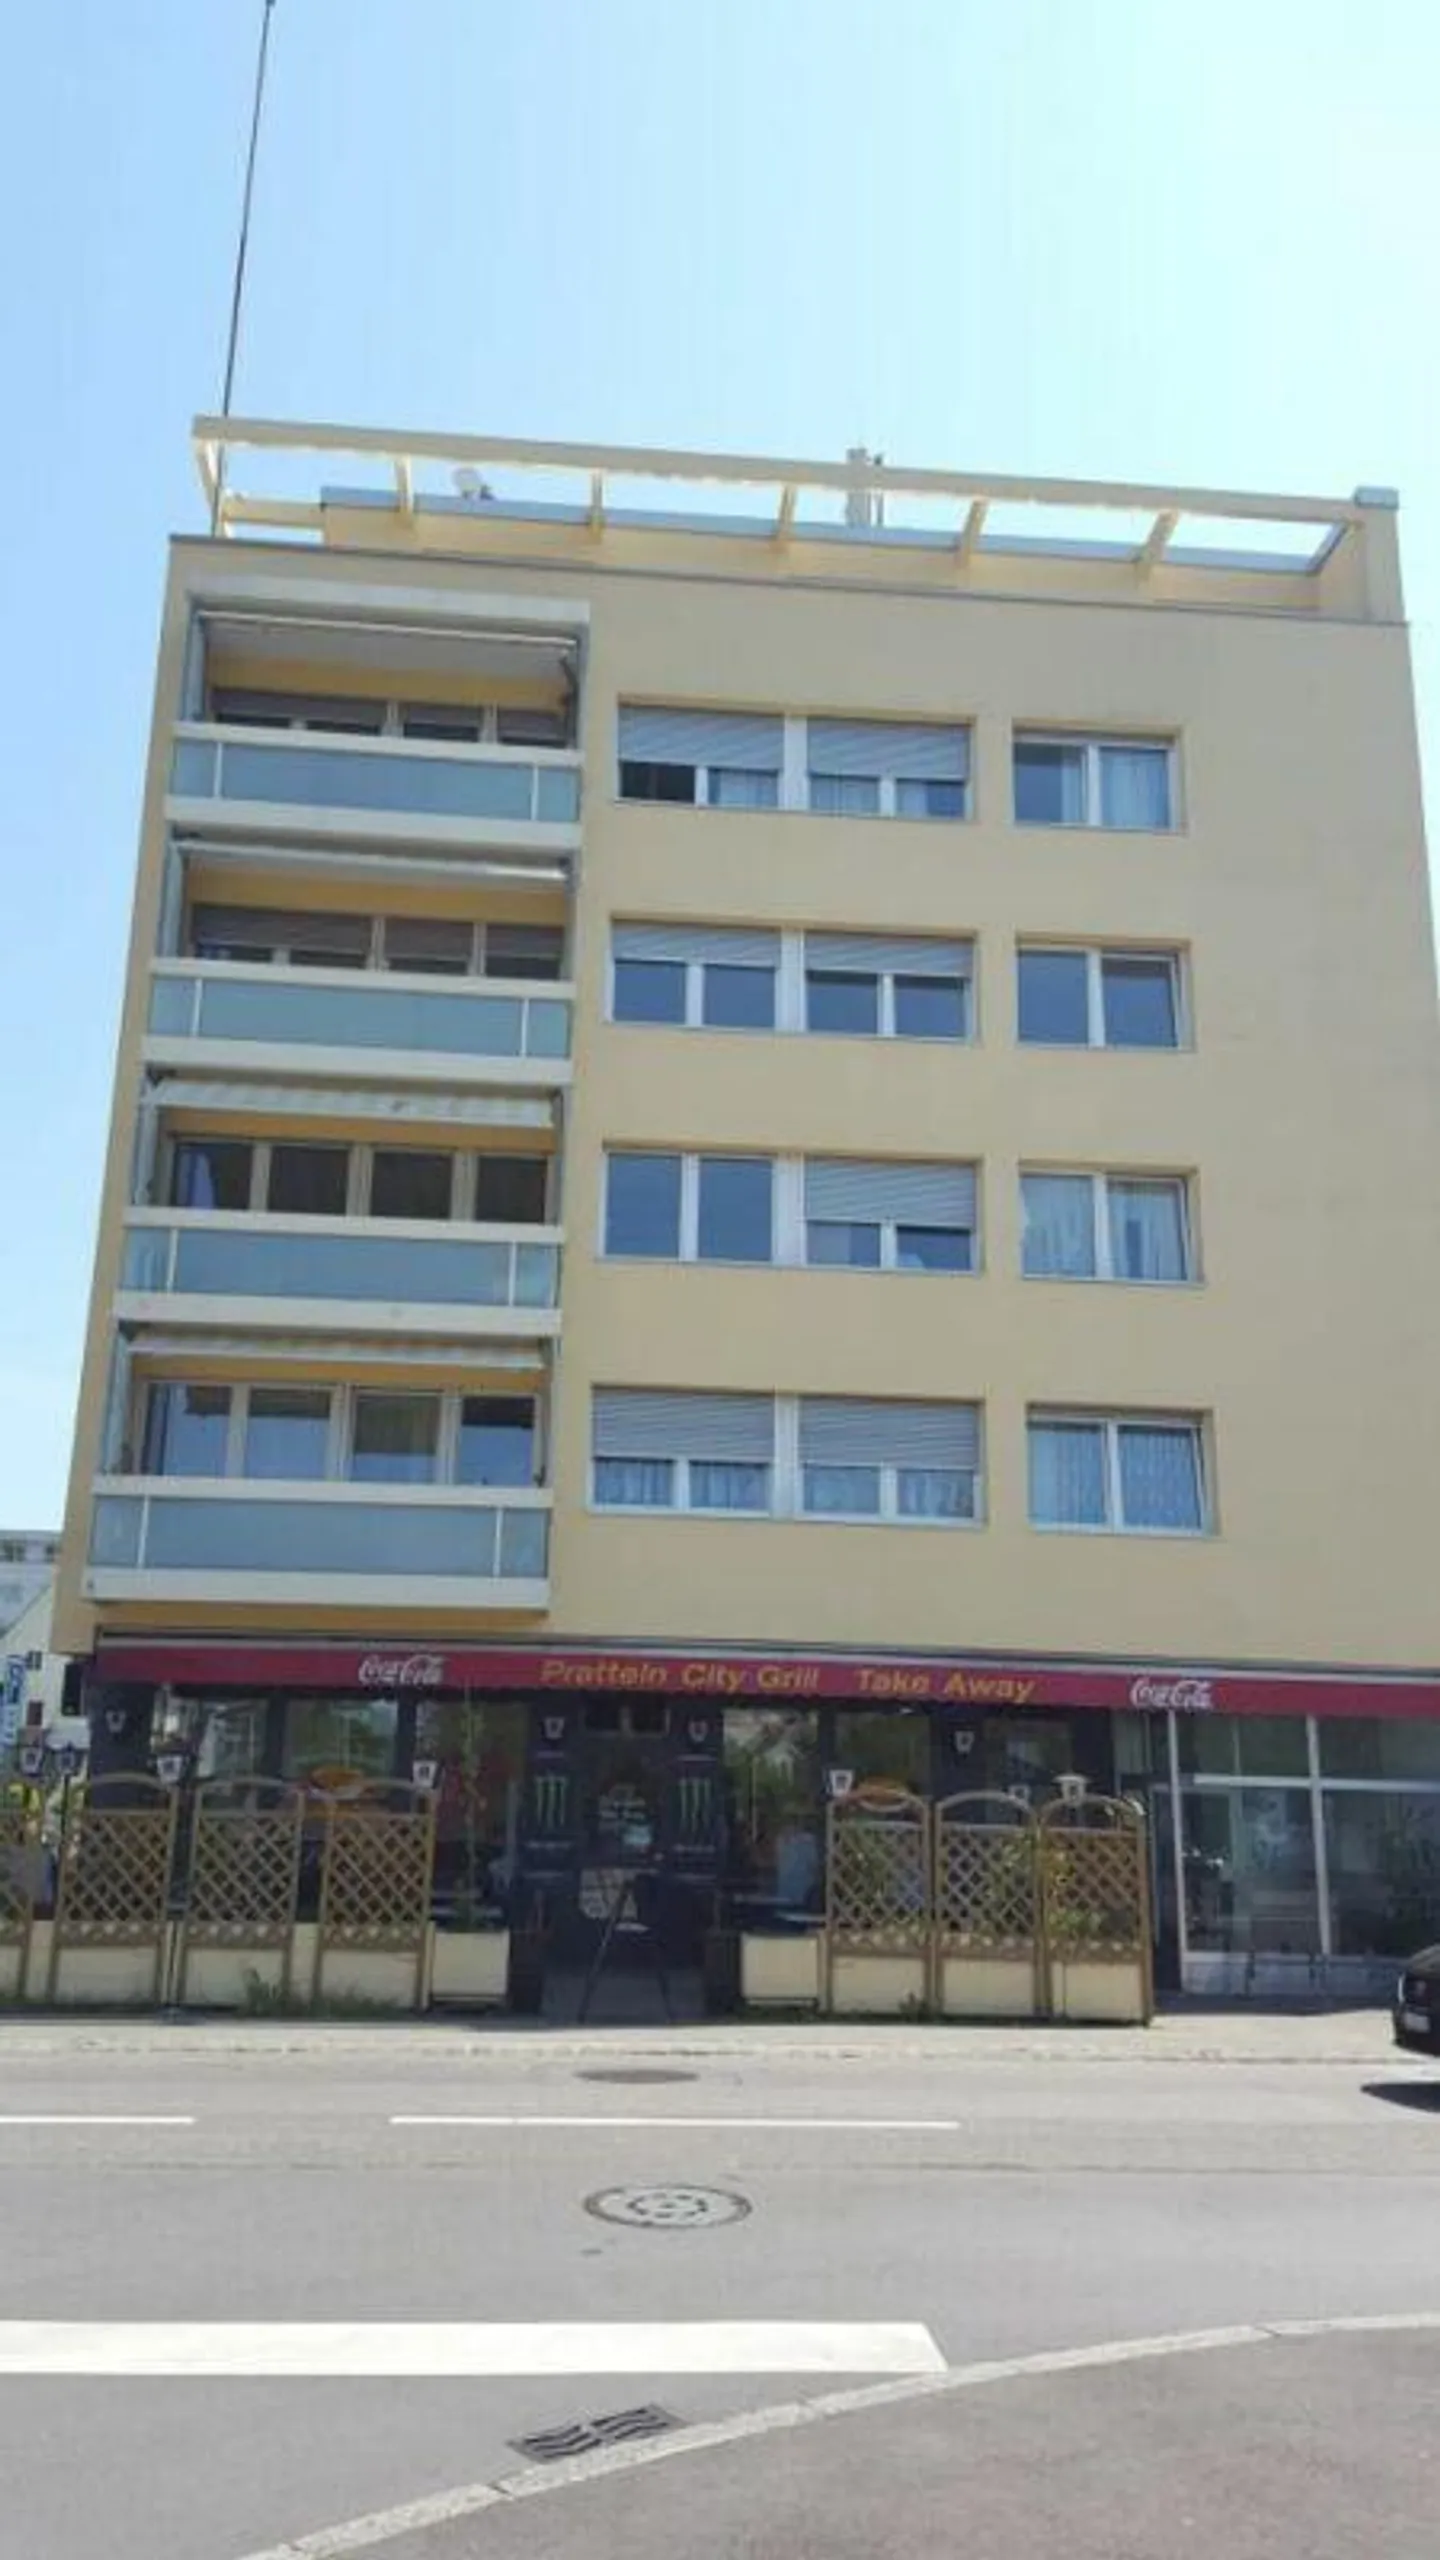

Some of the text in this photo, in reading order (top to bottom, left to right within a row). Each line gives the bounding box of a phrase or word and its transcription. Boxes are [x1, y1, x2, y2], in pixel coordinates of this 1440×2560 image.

[681, 1663, 745, 1691] City
[757, 1665, 820, 1689] Grill
[857, 1668, 930, 1692] Take
[944, 1672, 1035, 1703] Away
